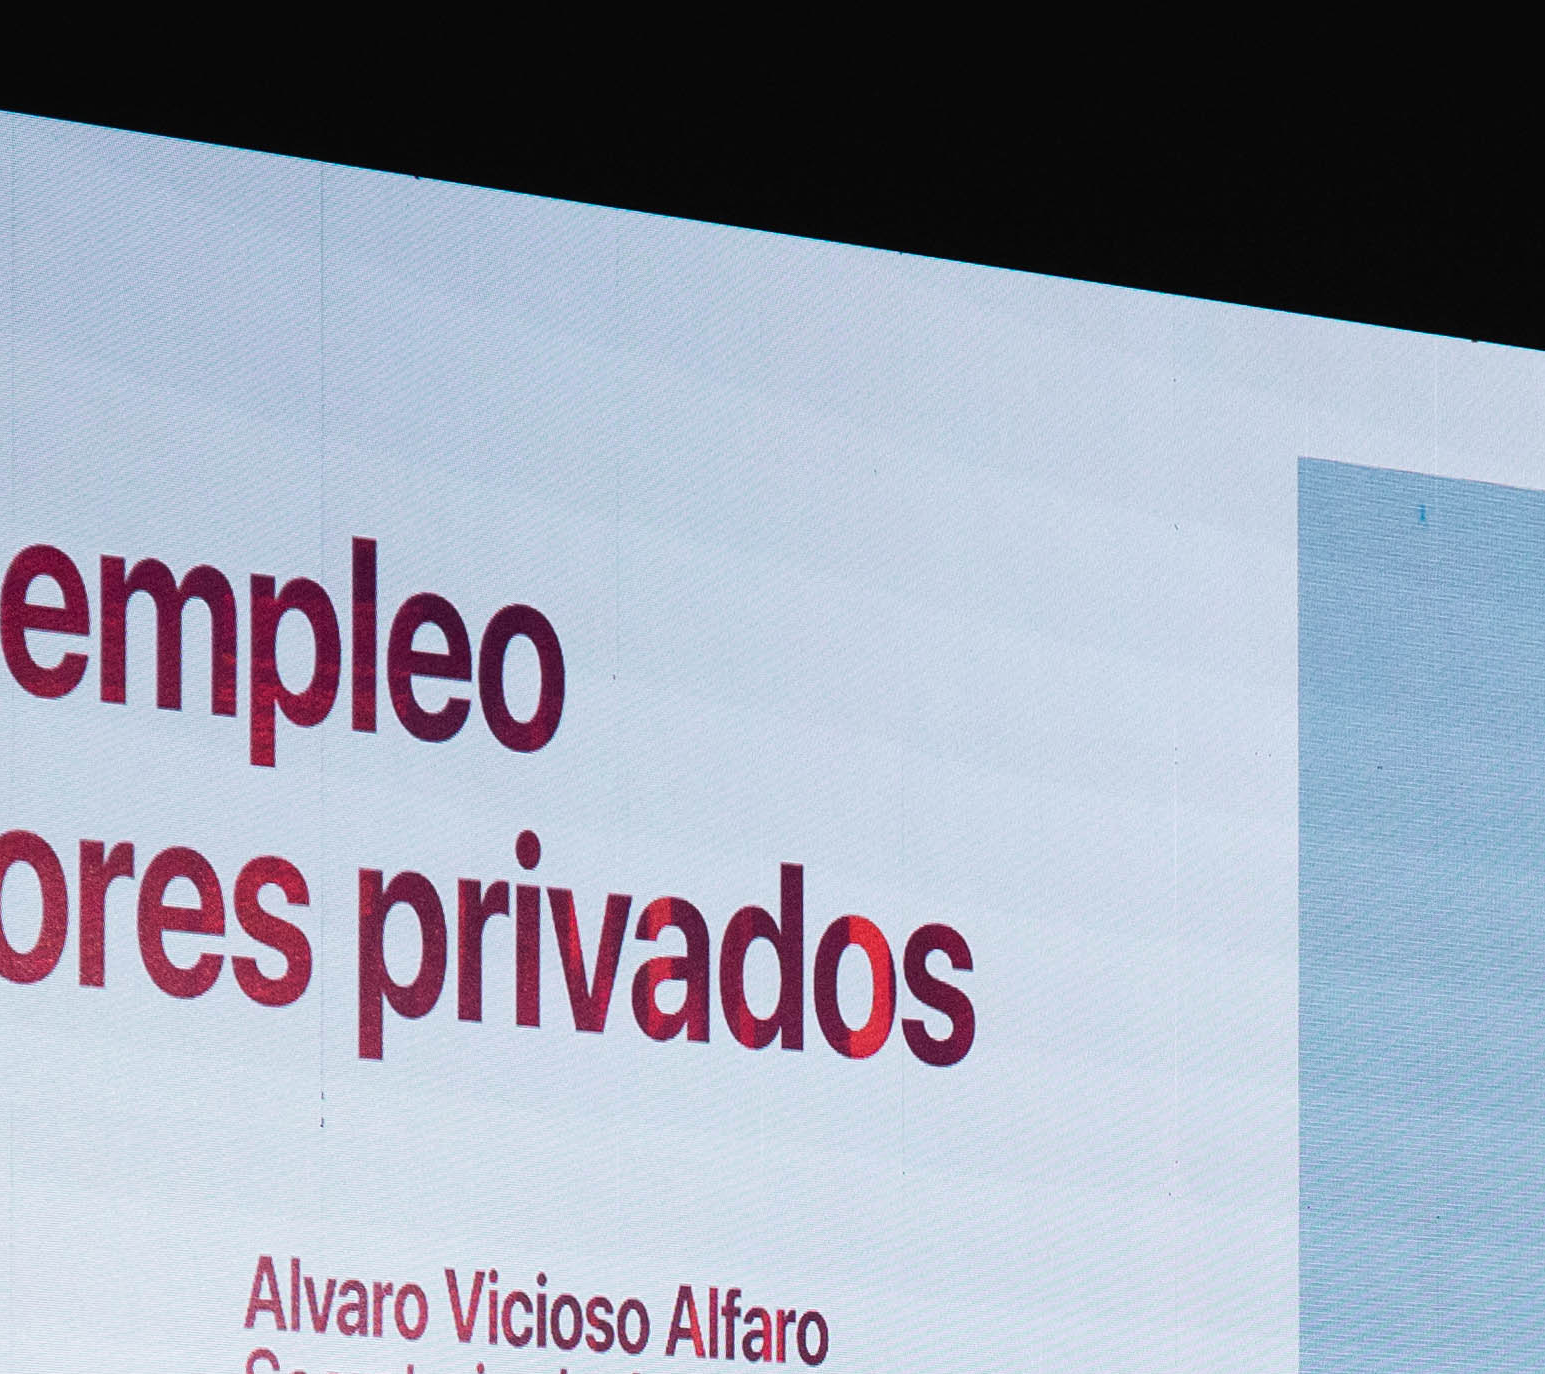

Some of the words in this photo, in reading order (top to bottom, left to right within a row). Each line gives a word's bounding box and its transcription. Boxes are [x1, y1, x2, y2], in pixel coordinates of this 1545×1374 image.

[357, 829, 977, 1068] privados
[244, 1255, 429, 1341] Alvaro
[445, 1268, 651, 1356] Vicioso
[665, 1284, 830, 1367] Alfaro
